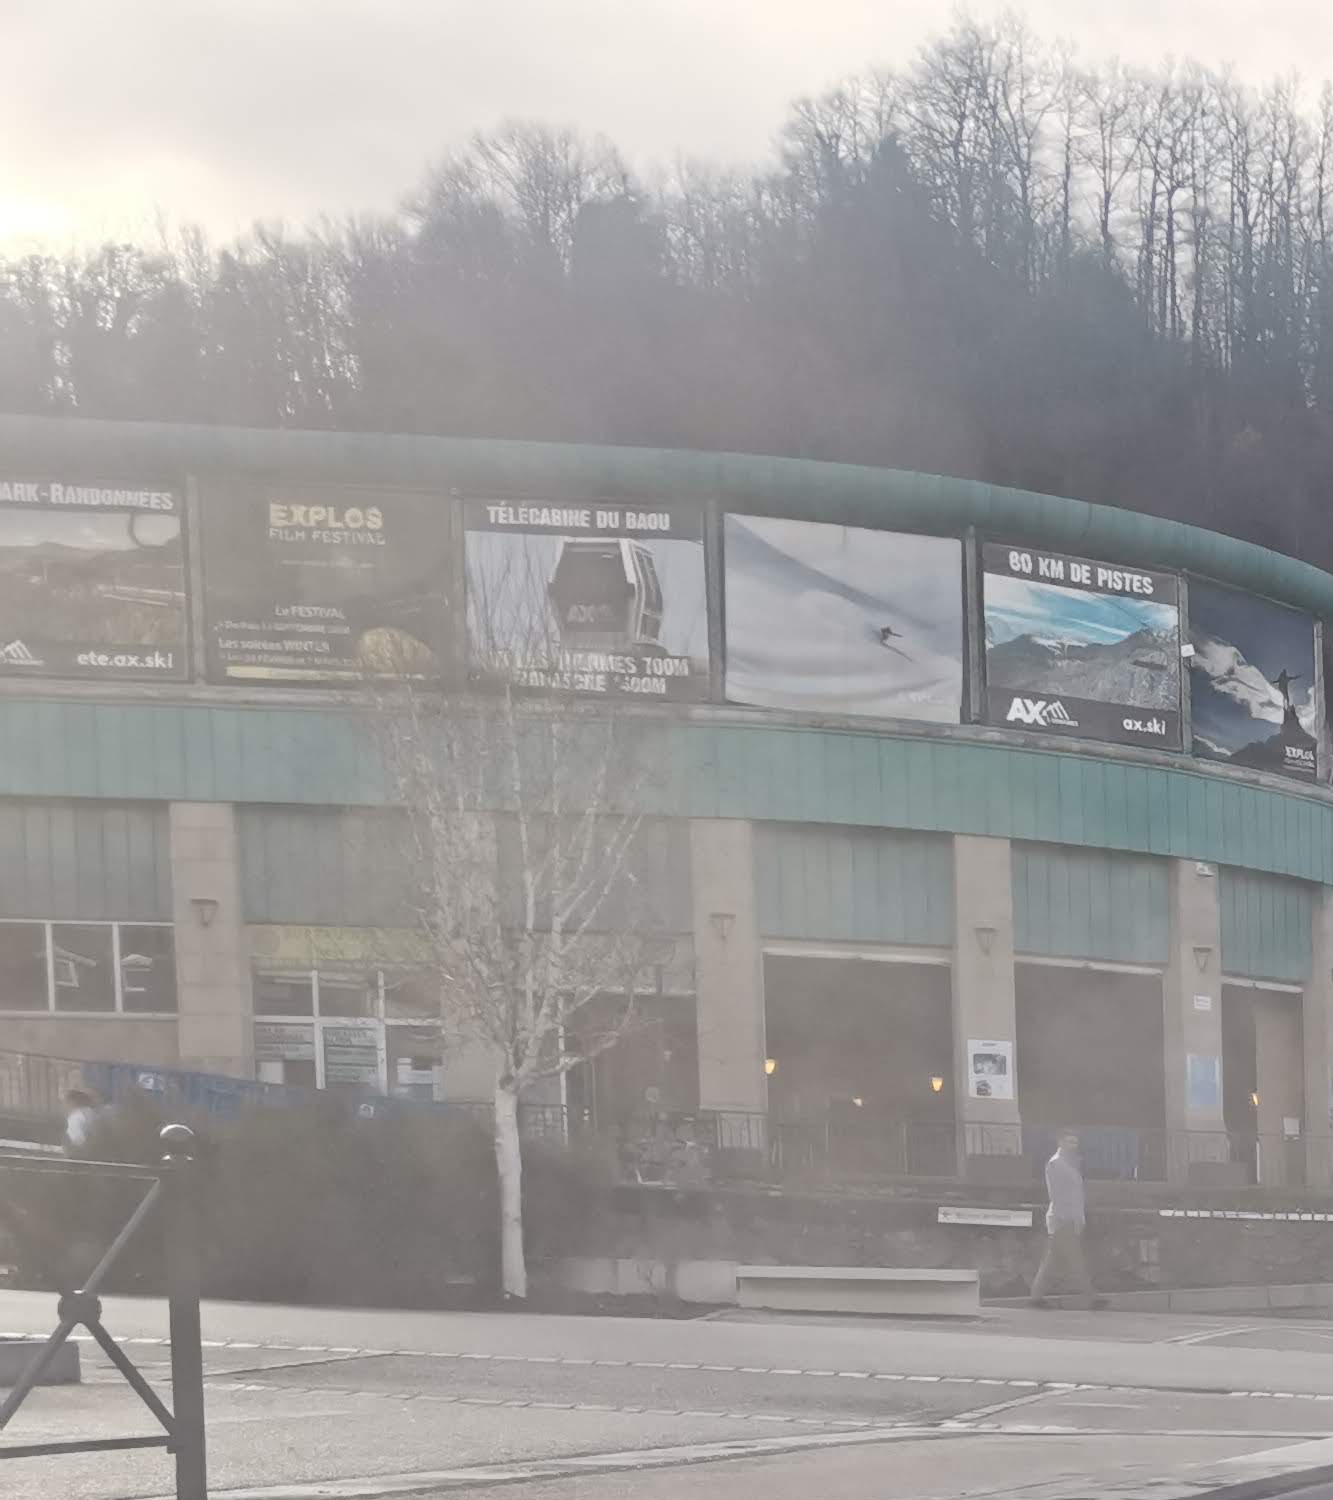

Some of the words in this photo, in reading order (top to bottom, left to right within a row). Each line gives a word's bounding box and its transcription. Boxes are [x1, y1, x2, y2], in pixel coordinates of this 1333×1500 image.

[270, 502, 384, 529] EXPLOS
[486, 501, 591, 528] TÉLÉCABINE
[596, 510, 619, 529] DU
[626, 512, 670, 530] BAOU
[269, 527, 305, 541] FILM
[312, 530, 386, 545] FESTIVAL
[1038, 557, 1065, 580] KM
[1070, 562, 1092, 585] DE
[1097, 567, 1154, 595] PISTES
[77, 650, 174, 669] ete.ax.ski
[643, 656, 689, 676] 700M
[1006, 697, 1048, 727] AX
[1122, 716, 1166, 736] ax.ski
